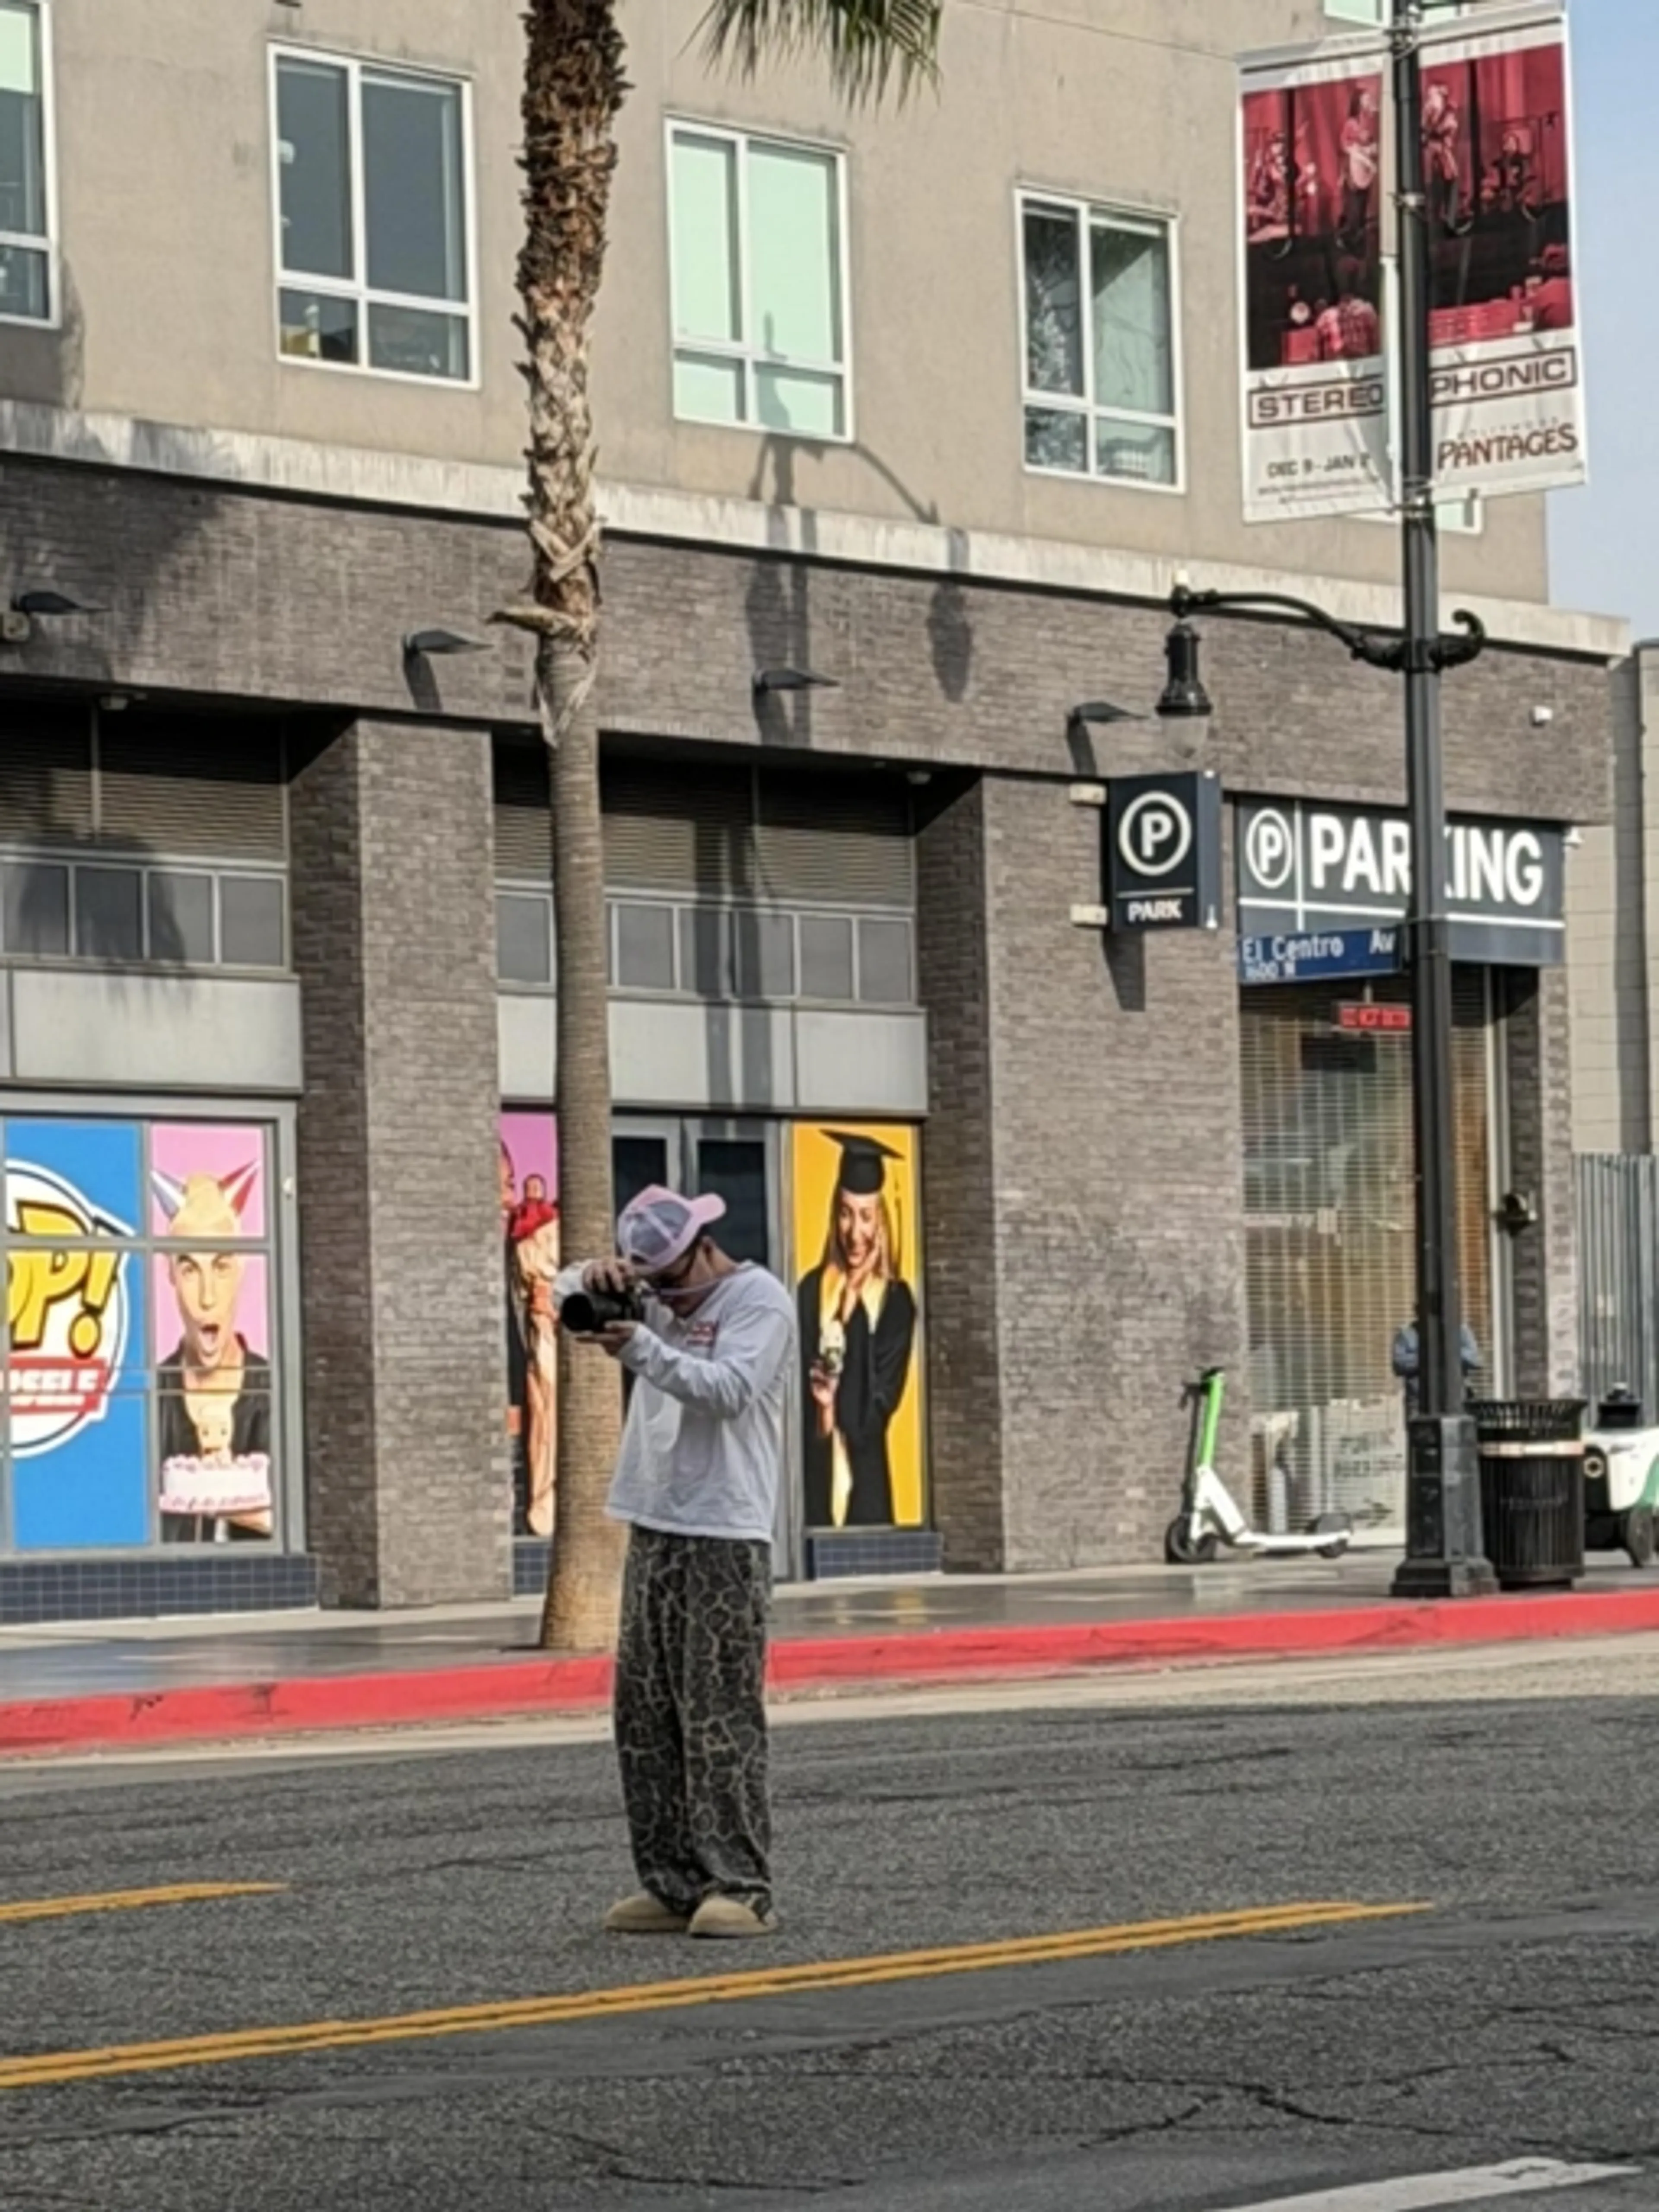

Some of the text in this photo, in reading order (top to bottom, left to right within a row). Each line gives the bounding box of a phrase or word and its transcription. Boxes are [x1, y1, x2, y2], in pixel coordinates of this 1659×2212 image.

[1428, 357, 1567, 397] PHONIC
[1258, 384, 1384, 418] STEREO
[1437, 422, 1578, 470] PANTAGES
[1141, 810, 1173, 859] P
[1127, 898, 1182, 923] PARK
[1243, 936, 1262, 963] El
[1271, 934, 1345, 961] Centro
